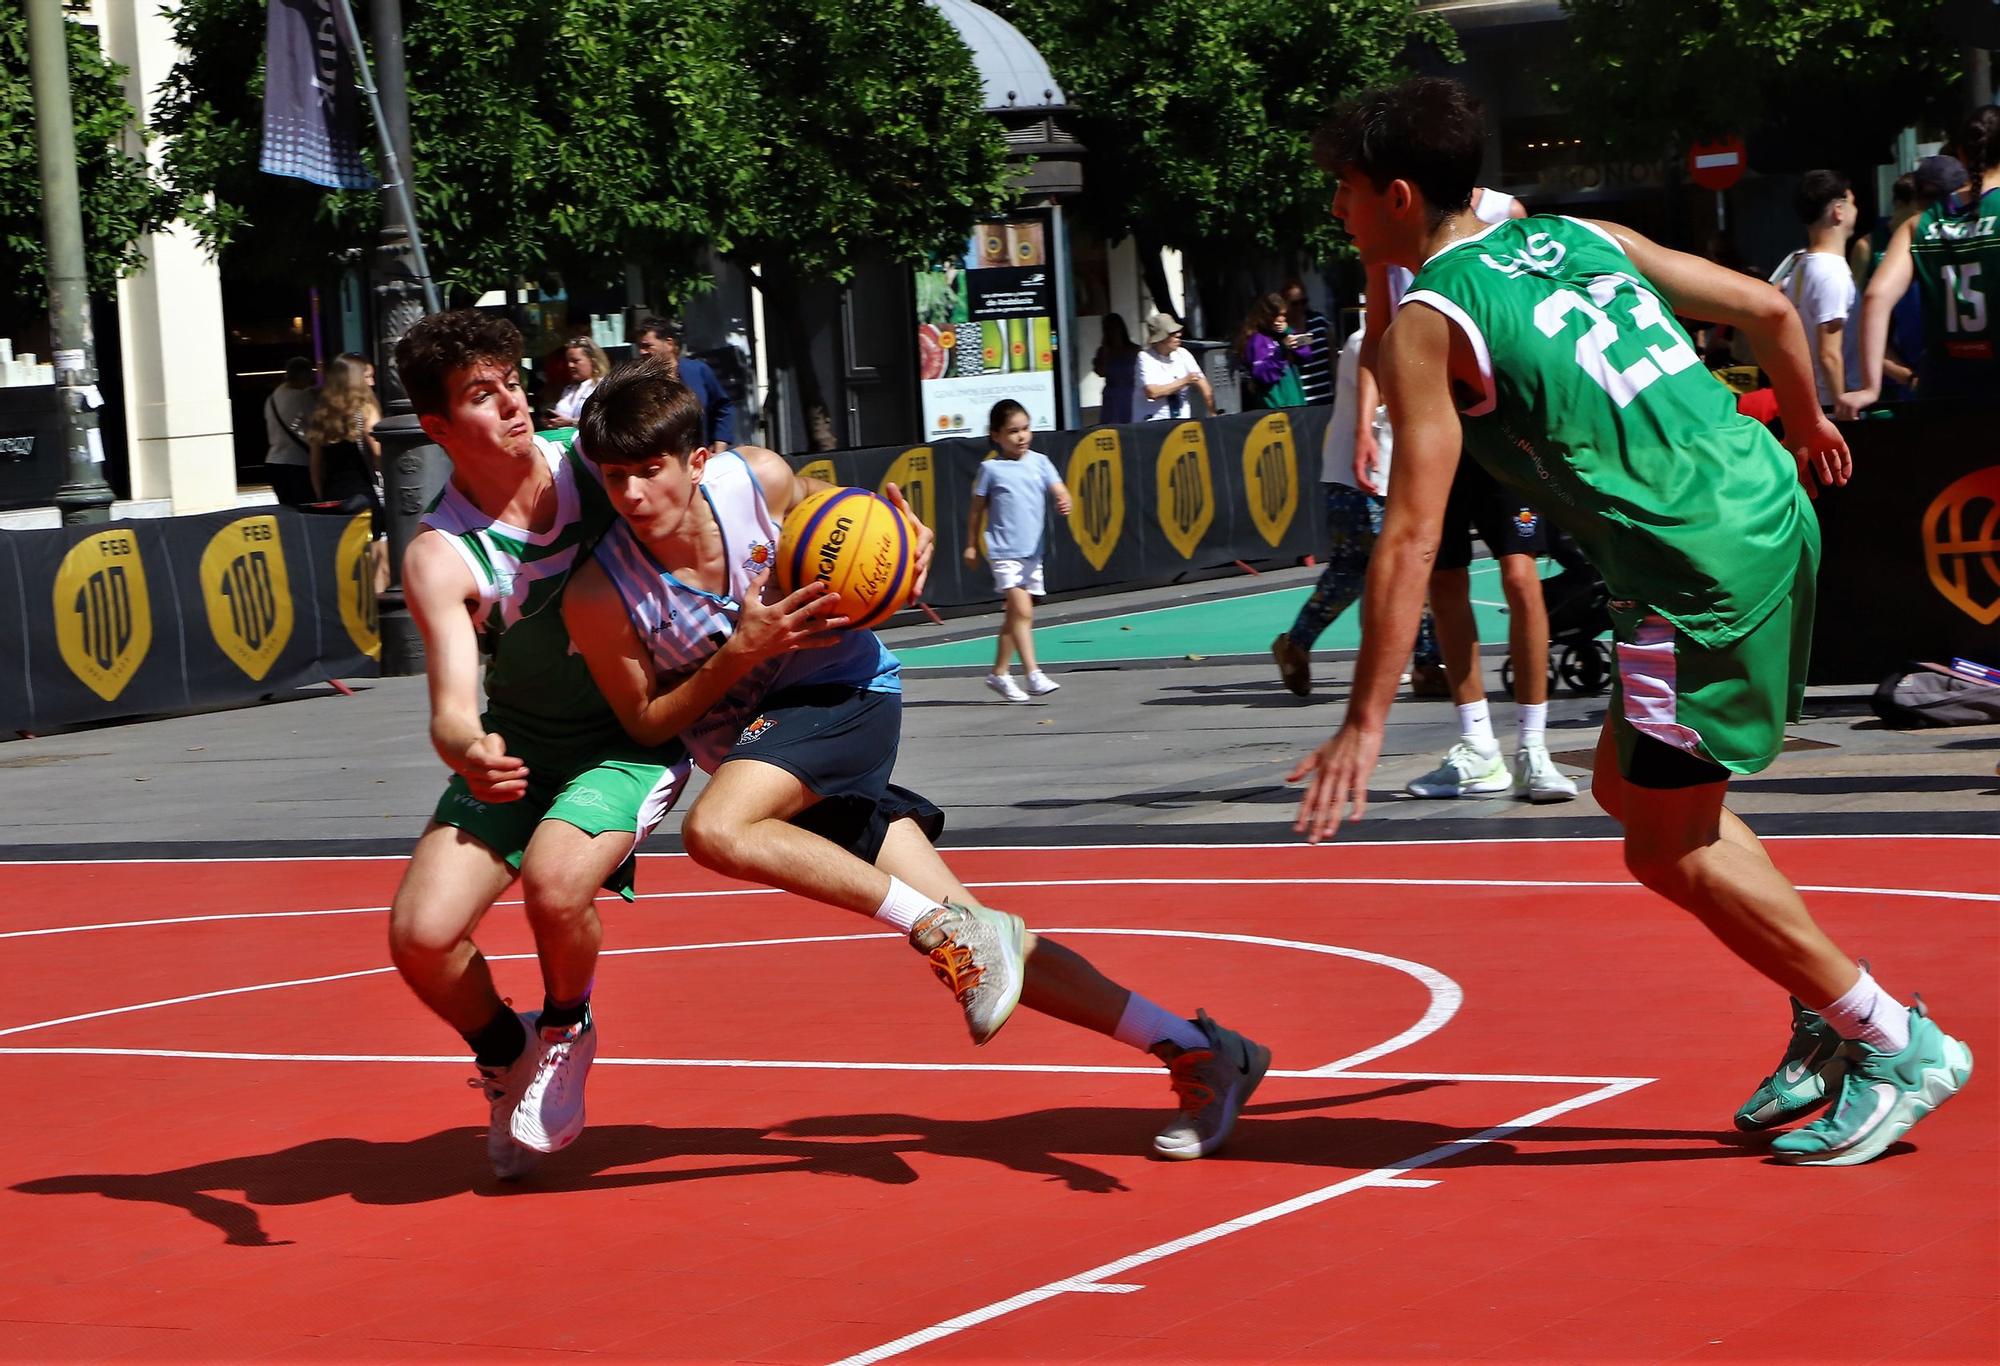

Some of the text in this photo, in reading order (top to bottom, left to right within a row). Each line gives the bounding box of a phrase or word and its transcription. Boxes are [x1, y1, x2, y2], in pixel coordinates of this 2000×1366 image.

[1941, 262, 1987, 332] 15
[1534, 272, 1700, 408] 23
[1269, 420, 1286, 433] FEB
[1095, 437, 1115, 451] FEB
[1183, 430, 1200, 443] FEB
[909, 456, 929, 471] FEB
[242, 524, 272, 541] FEB
[99, 538, 131, 557] FEB
[221, 550, 276, 650] 100
[74, 565, 132, 671] 100
